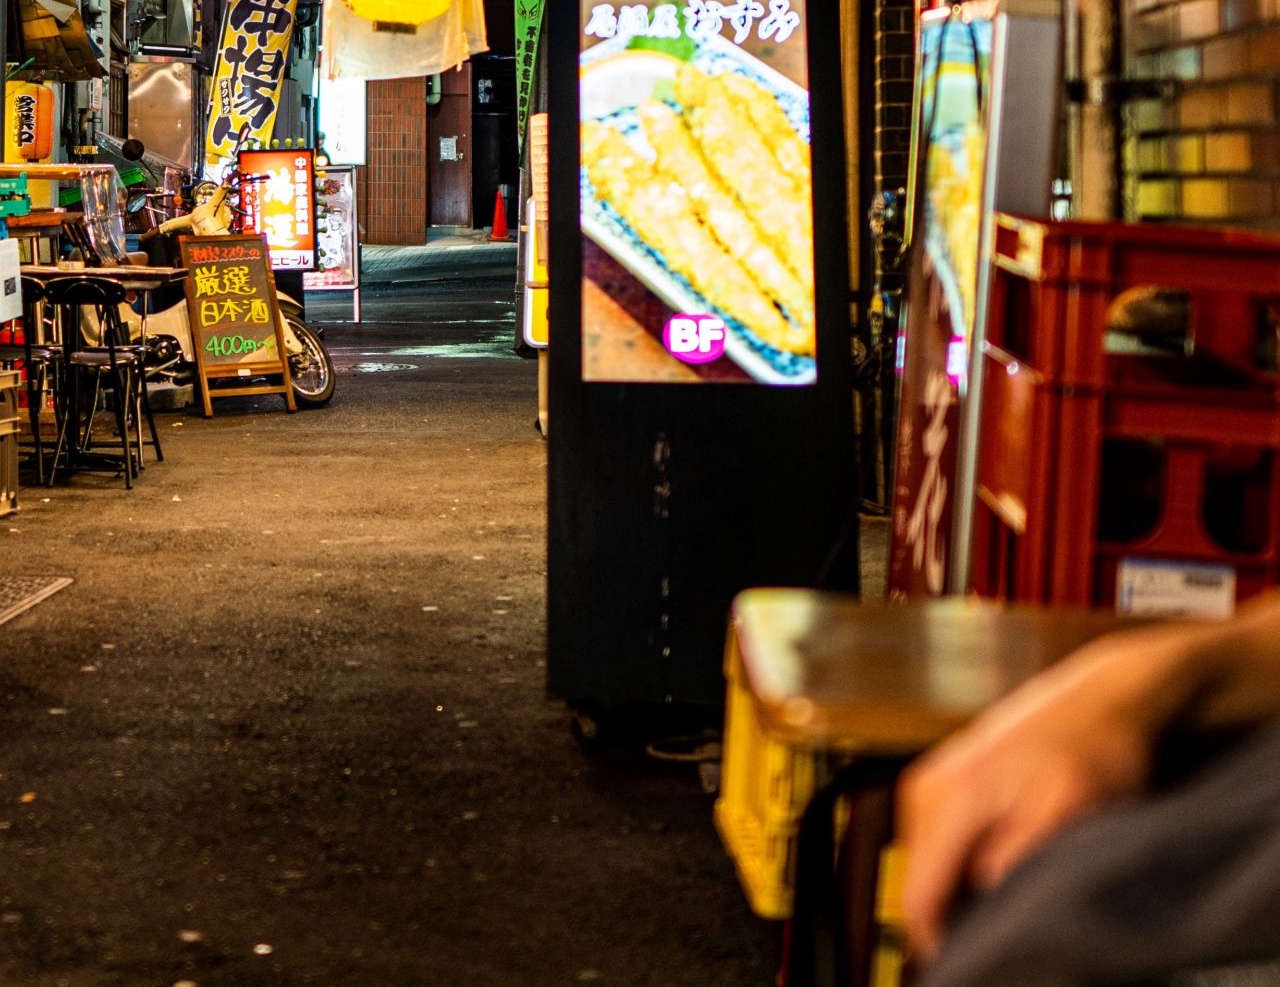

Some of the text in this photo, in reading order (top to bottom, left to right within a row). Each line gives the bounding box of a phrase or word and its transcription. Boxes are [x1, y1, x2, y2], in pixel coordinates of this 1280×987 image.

[195, 265, 257, 298] 厳選
[201, 299, 270, 327] 日本酒
[668, 318, 726, 353] BF
